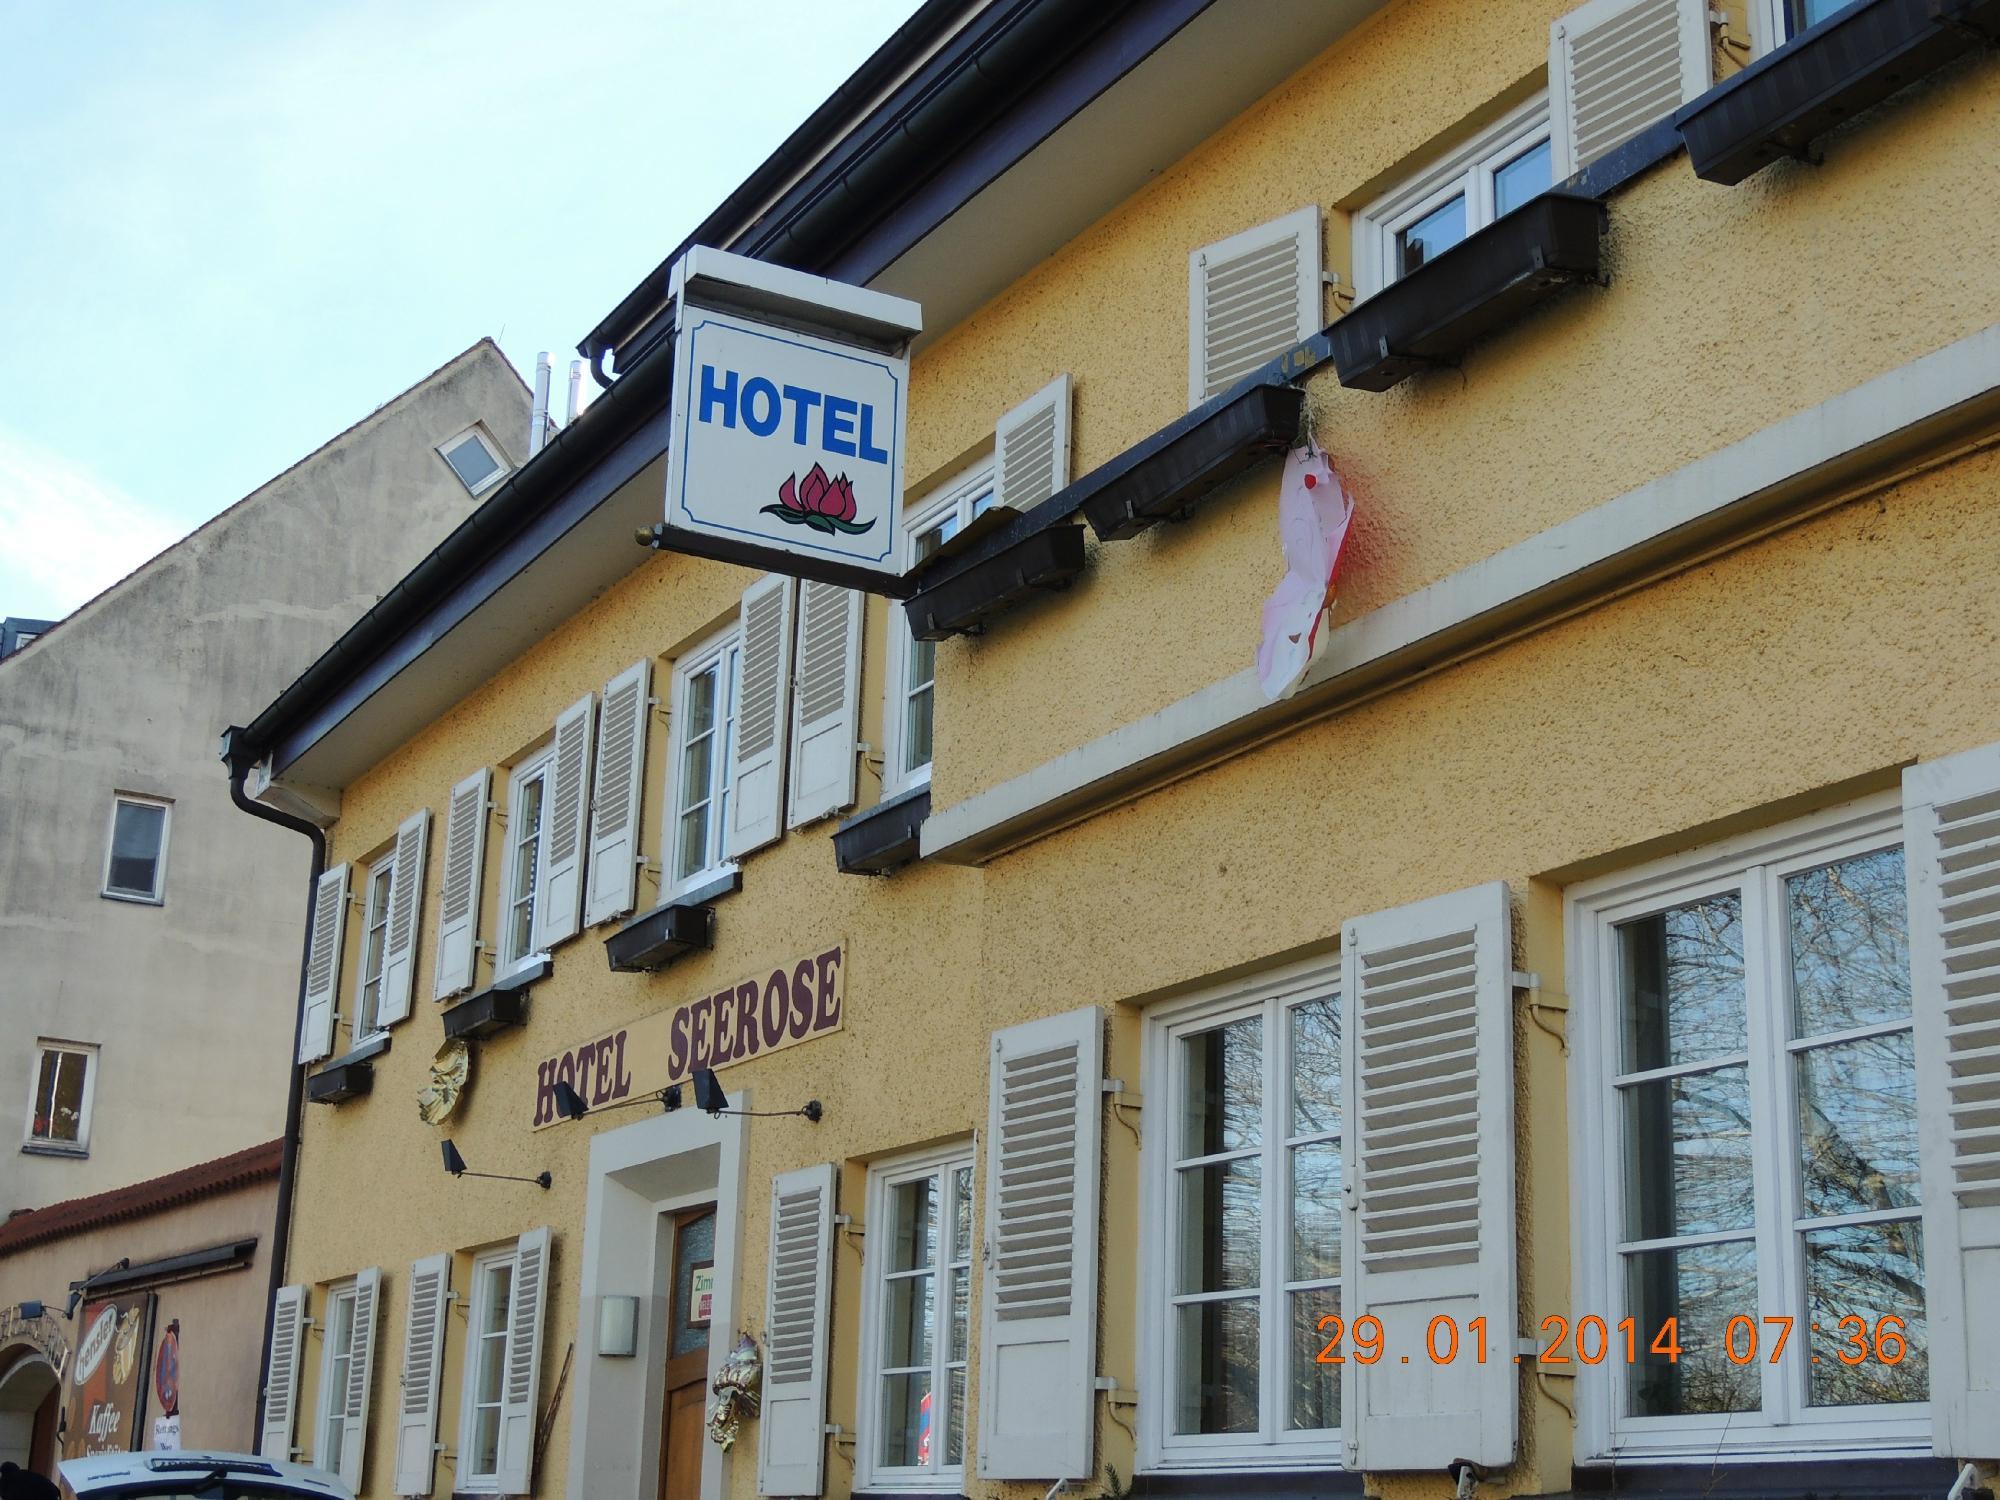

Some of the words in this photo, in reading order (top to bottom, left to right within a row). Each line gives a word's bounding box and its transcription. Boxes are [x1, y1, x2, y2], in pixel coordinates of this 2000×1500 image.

[698, 363, 888, 465] HOTEL
[533, 1029, 631, 1127] HOTEL
[667, 946, 841, 1081] SEEROSE
[88, 1402, 121, 1442] Kaffee
